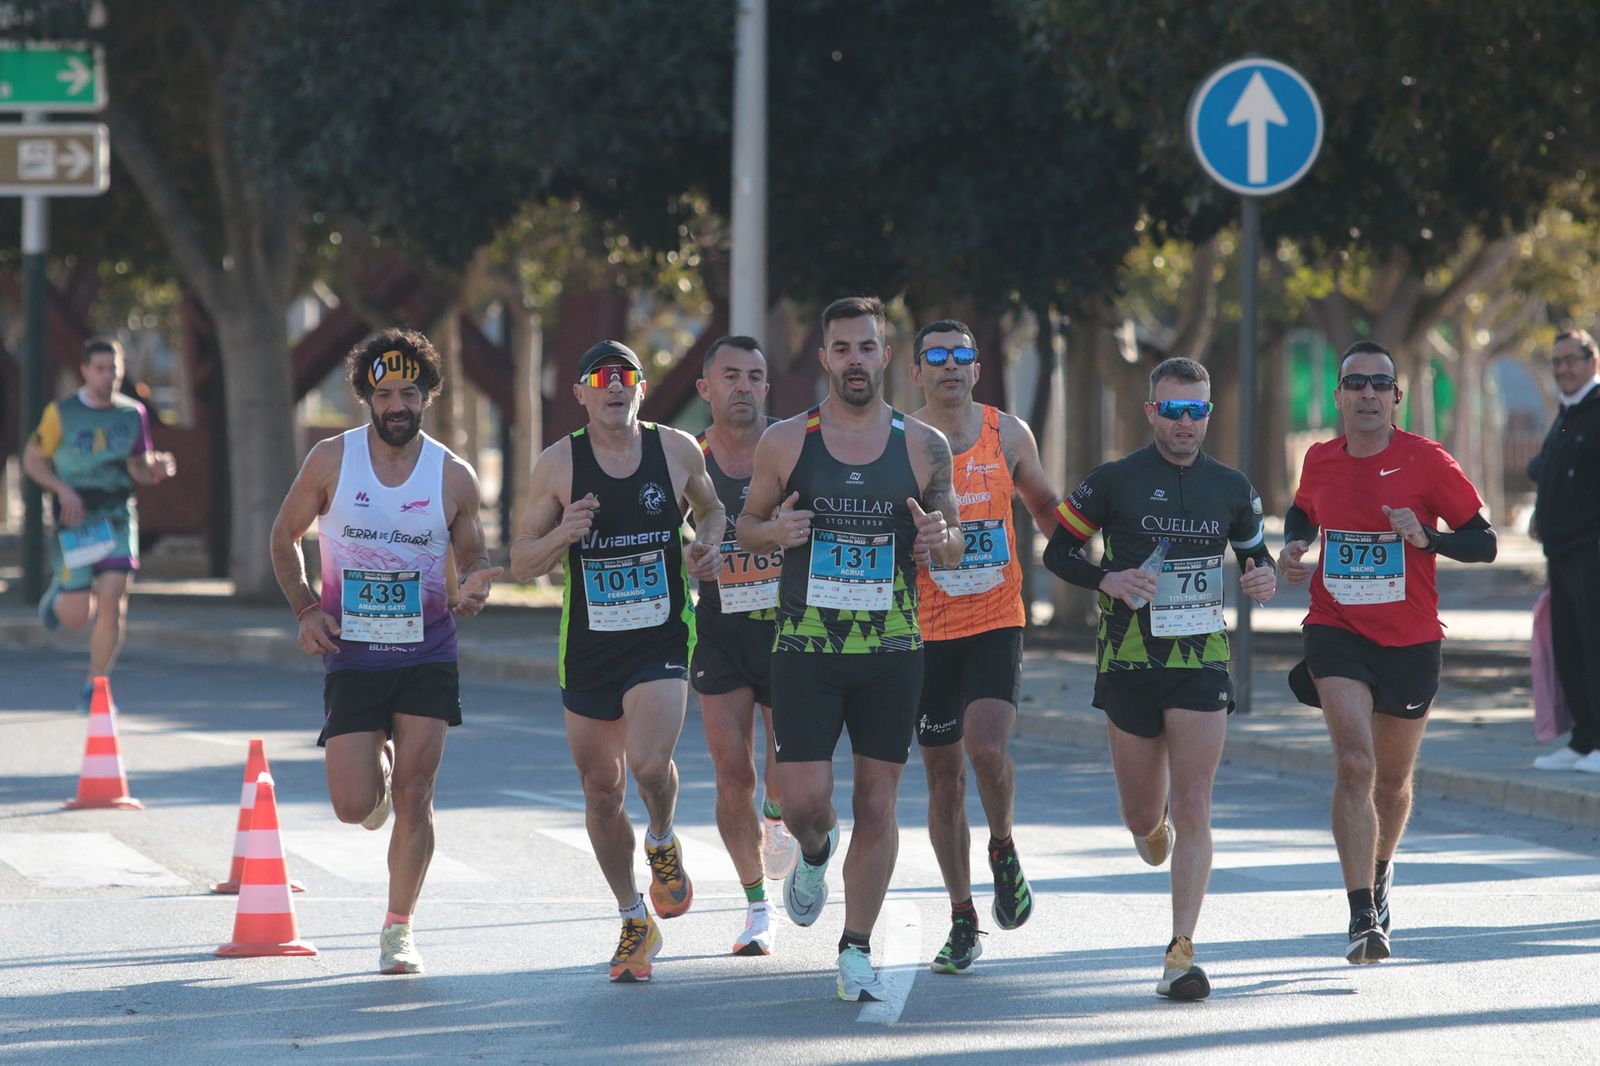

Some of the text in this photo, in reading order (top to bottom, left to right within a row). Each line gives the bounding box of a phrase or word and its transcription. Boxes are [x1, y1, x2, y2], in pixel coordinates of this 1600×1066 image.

[813, 497, 894, 515] CUELLAR
[826, 518, 884, 527] STONE 1958
[1141, 515, 1220, 534] CUELLAR
[342, 525, 429, 546] SIERRA DE SEGURA
[724, 547, 784, 573] 1765
[830, 545, 877, 569] 131
[965, 554, 992, 562] SEGURA
[1339, 544, 1388, 566] 979
[594, 566, 659, 592] 1015
[840, 568, 865, 576] ACRUZ
[1177, 571, 1208, 594] 76
[359, 583, 406, 604] 439
[607, 589, 645, 599] FERNANDO
